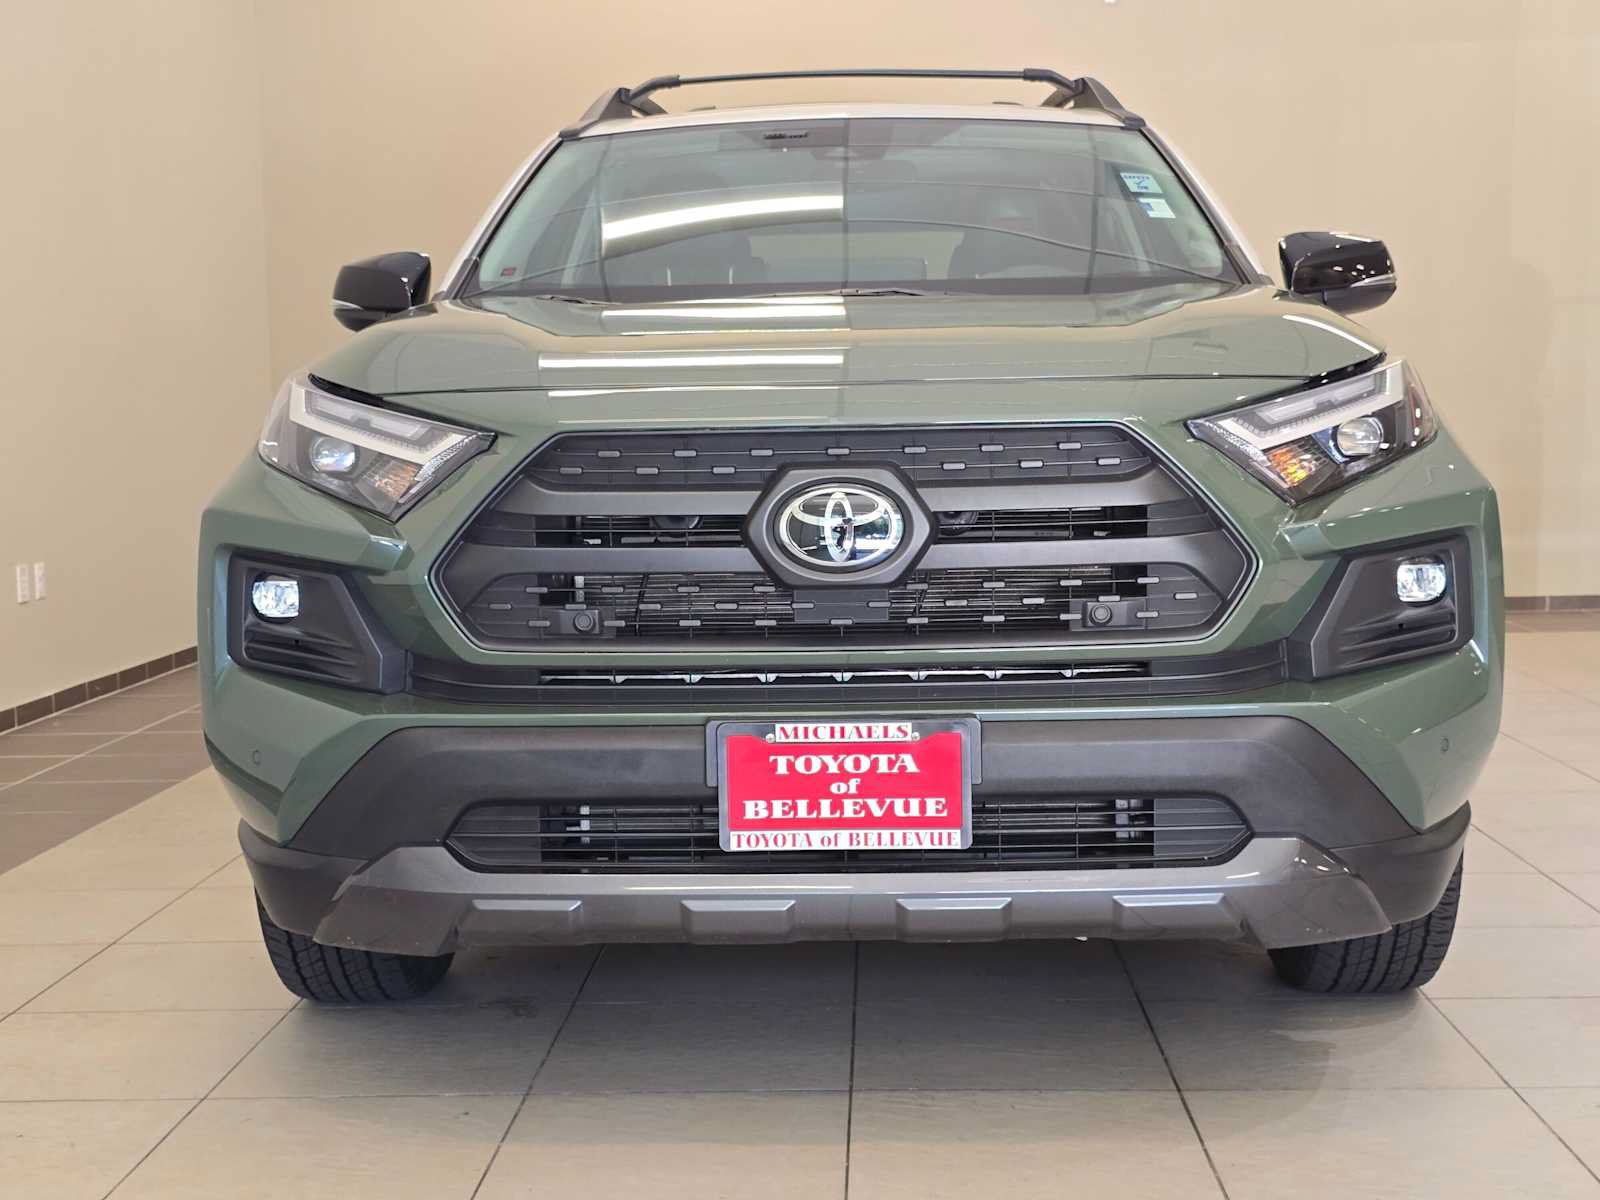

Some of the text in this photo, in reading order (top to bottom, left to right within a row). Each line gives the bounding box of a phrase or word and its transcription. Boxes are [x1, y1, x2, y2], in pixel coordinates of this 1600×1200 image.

[778, 724, 910, 740] MICHAELS
[769, 754, 920, 775] TOYOTA
[830, 778, 861, 795] of
[743, 797, 948, 819] BELLEVUE
[732, 831, 959, 849] TOYOTA of BELLEVUE
